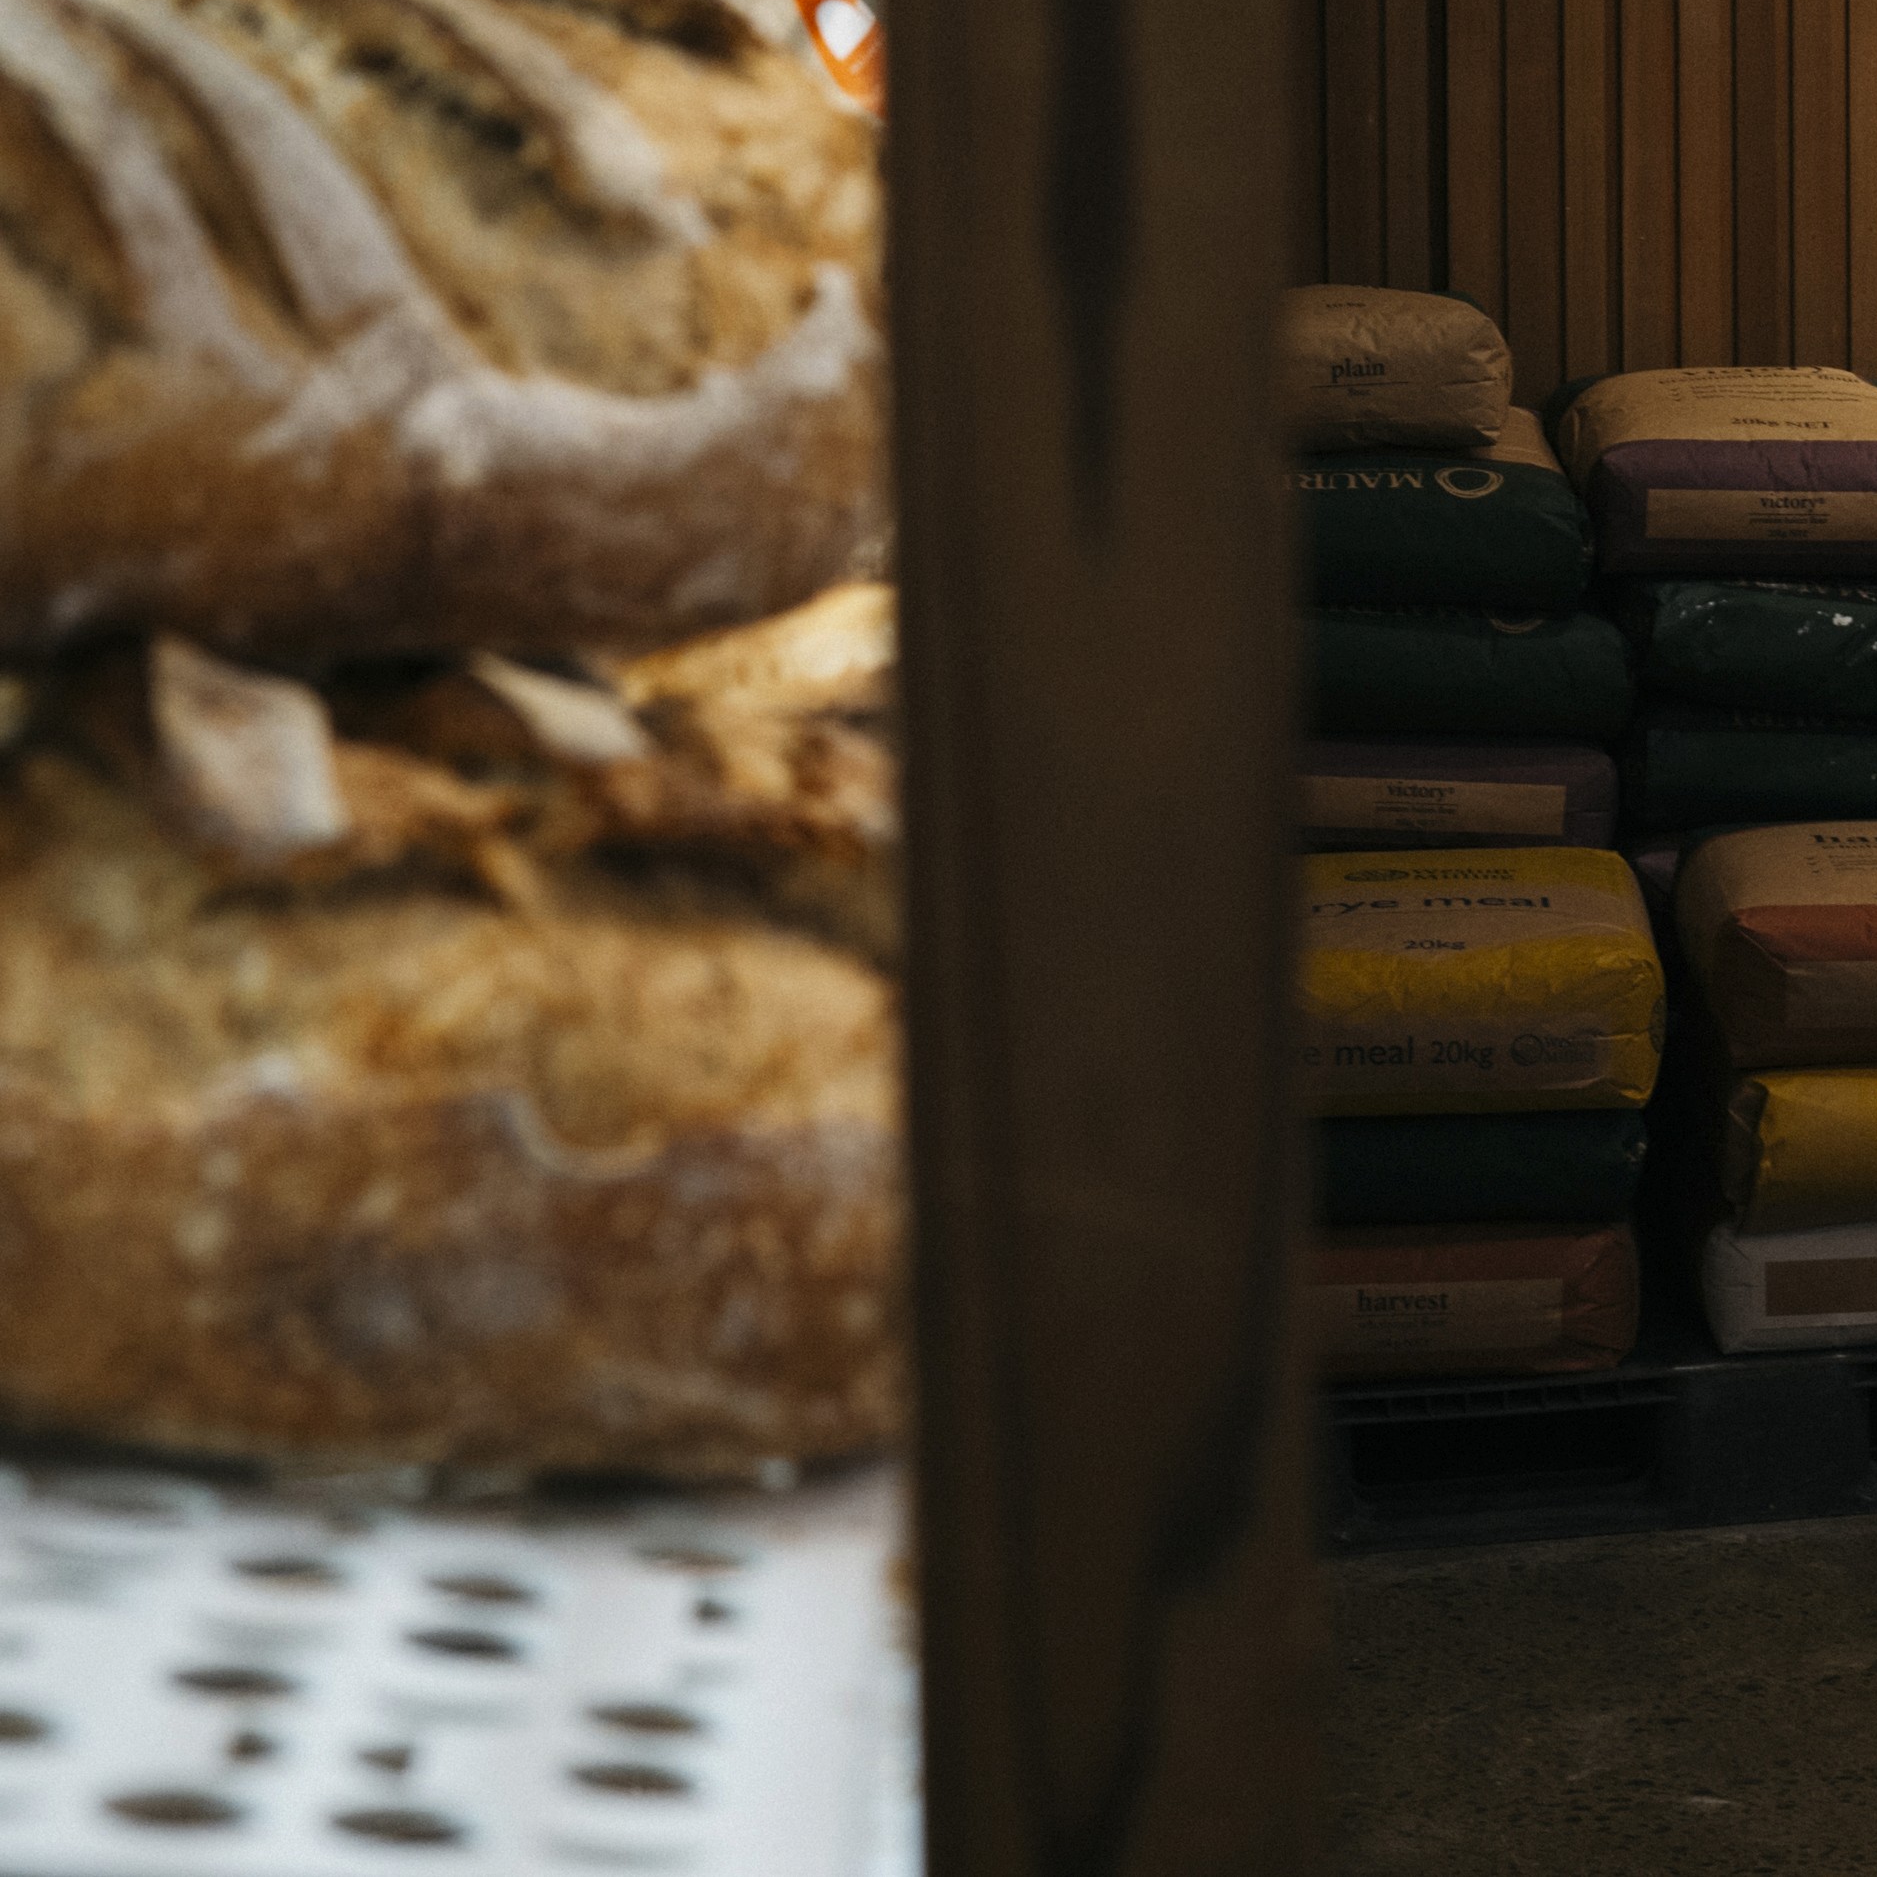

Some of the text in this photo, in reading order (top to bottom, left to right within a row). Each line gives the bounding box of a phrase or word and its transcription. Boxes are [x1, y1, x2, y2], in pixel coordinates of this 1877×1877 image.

[1331, 357, 1385, 383] plain
[1785, 417, 1833, 429] NET
[1311, 896, 1552, 915] rye meal
[1405, 939, 1467, 951] 20kg
[1335, 1036, 1413, 1065] meal
[1430, 1040, 1494, 1070] 20kg
[1357, 1288, 1449, 1312] harvest
